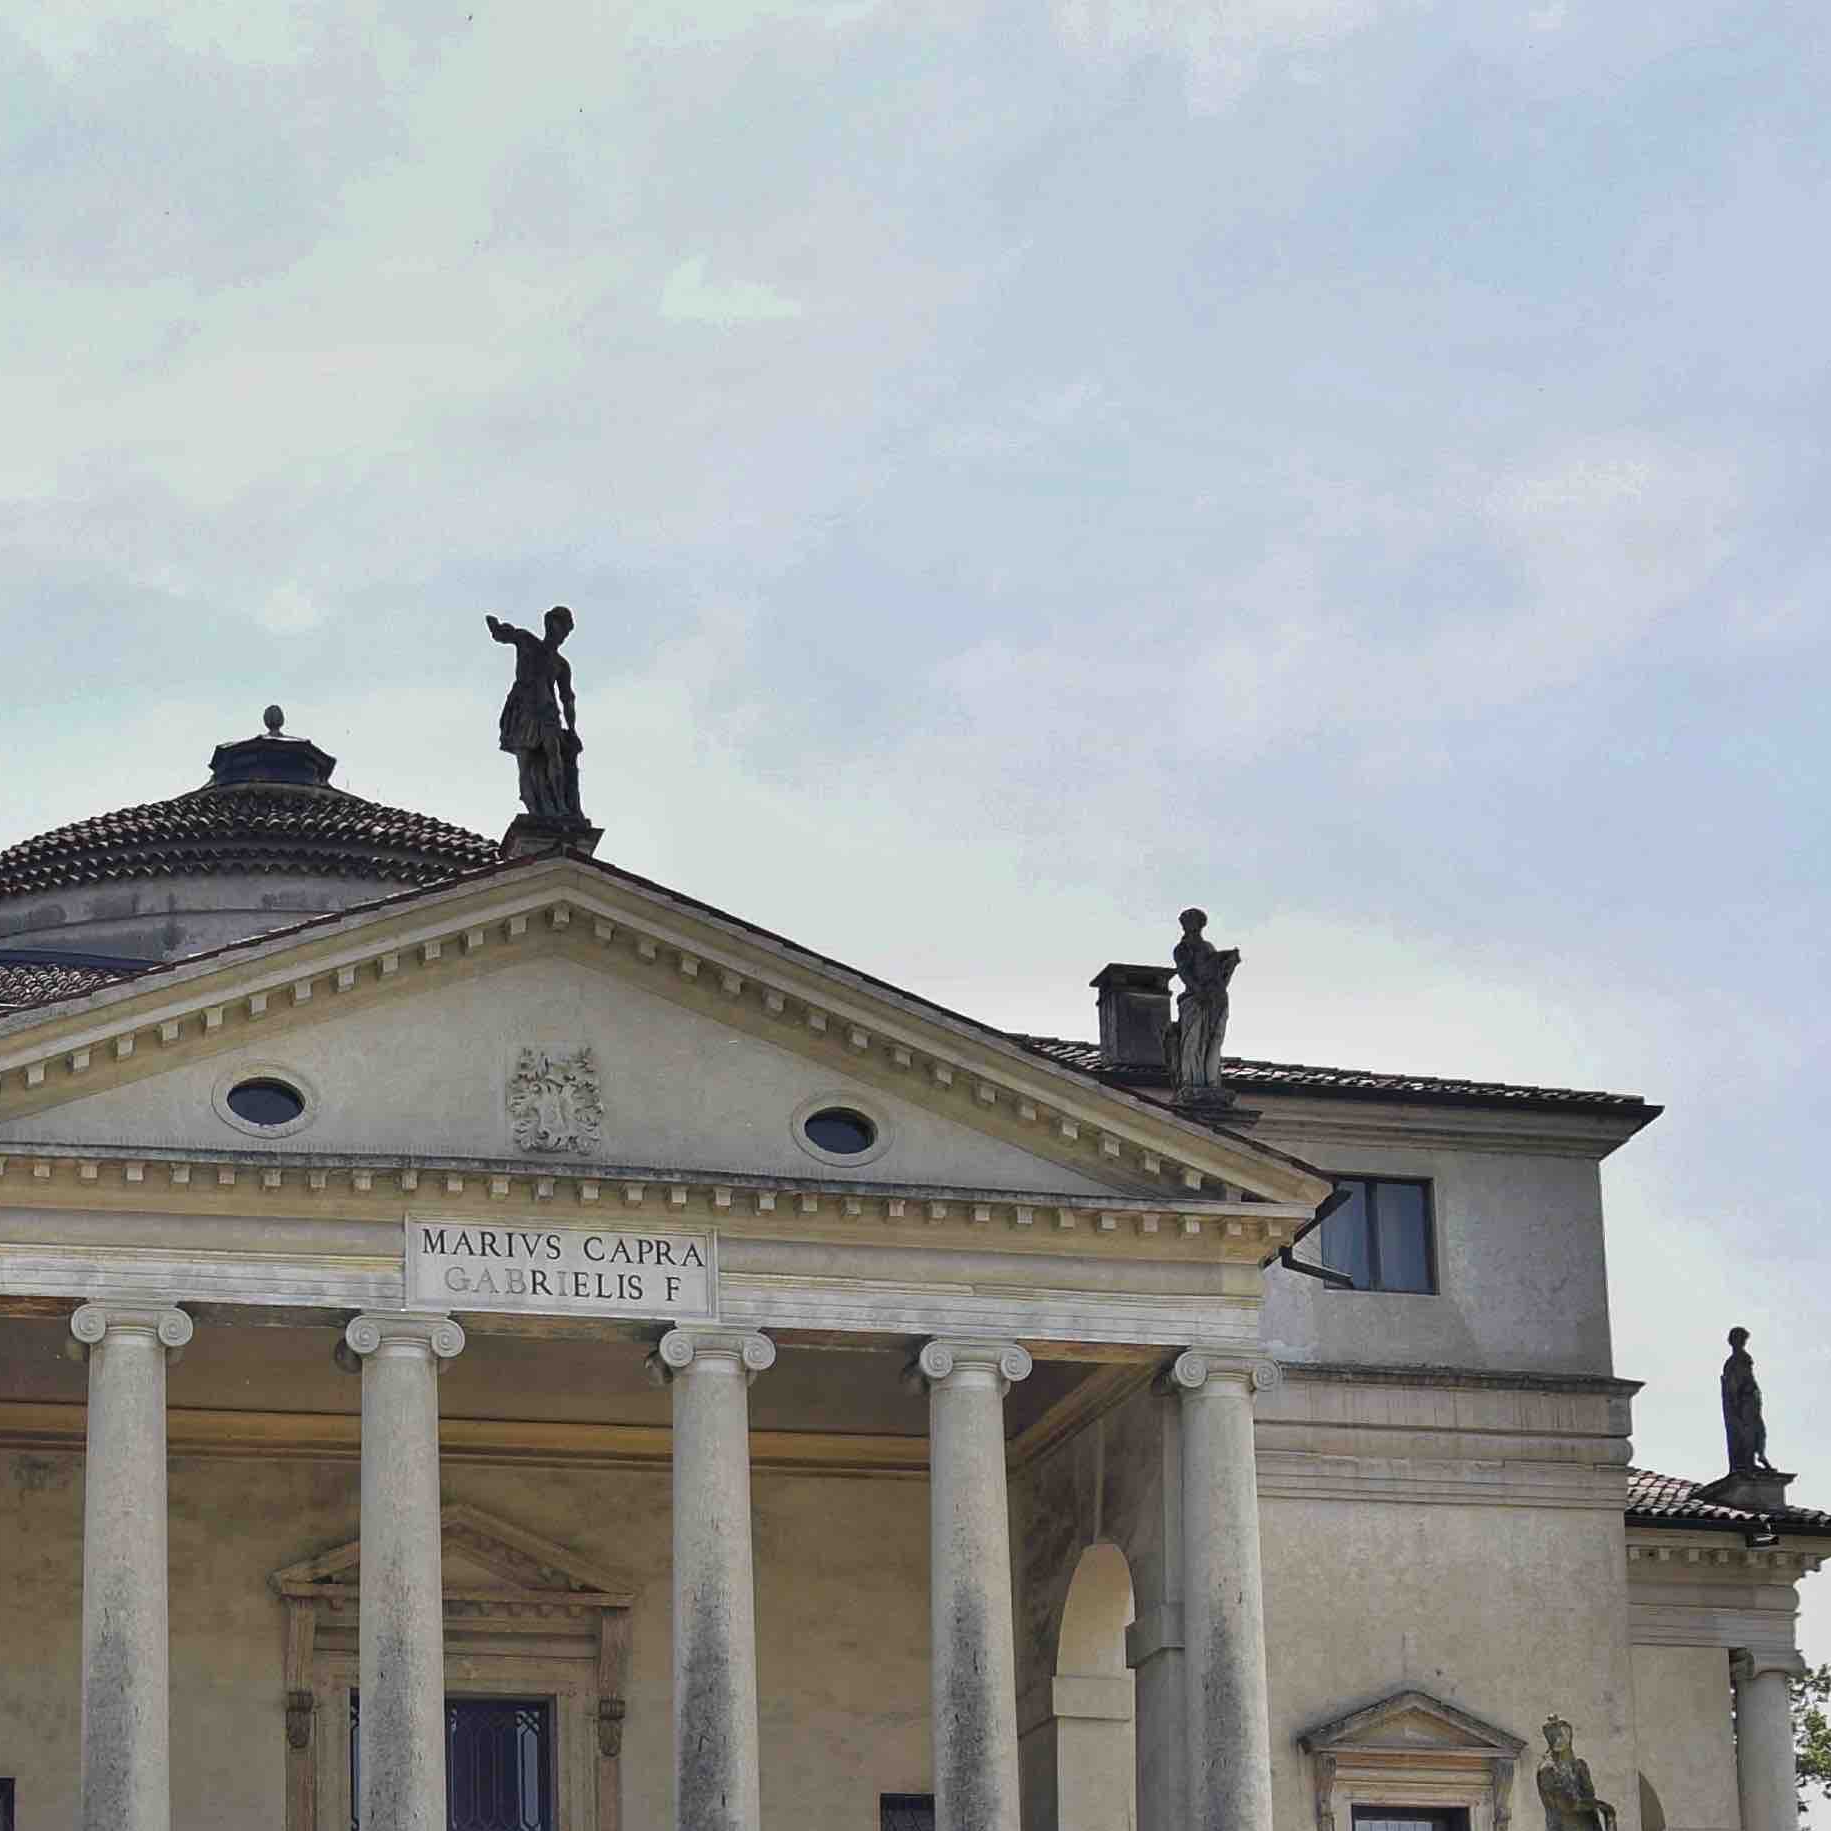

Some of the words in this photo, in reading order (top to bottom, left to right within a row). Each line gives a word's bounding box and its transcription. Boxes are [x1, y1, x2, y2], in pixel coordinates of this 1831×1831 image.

[422, 1228, 561, 1260] MARIVS
[583, 1236, 704, 1267] CAPRA
[444, 1266, 644, 1300] GABRIELIS
[664, 1276, 682, 1301] F
